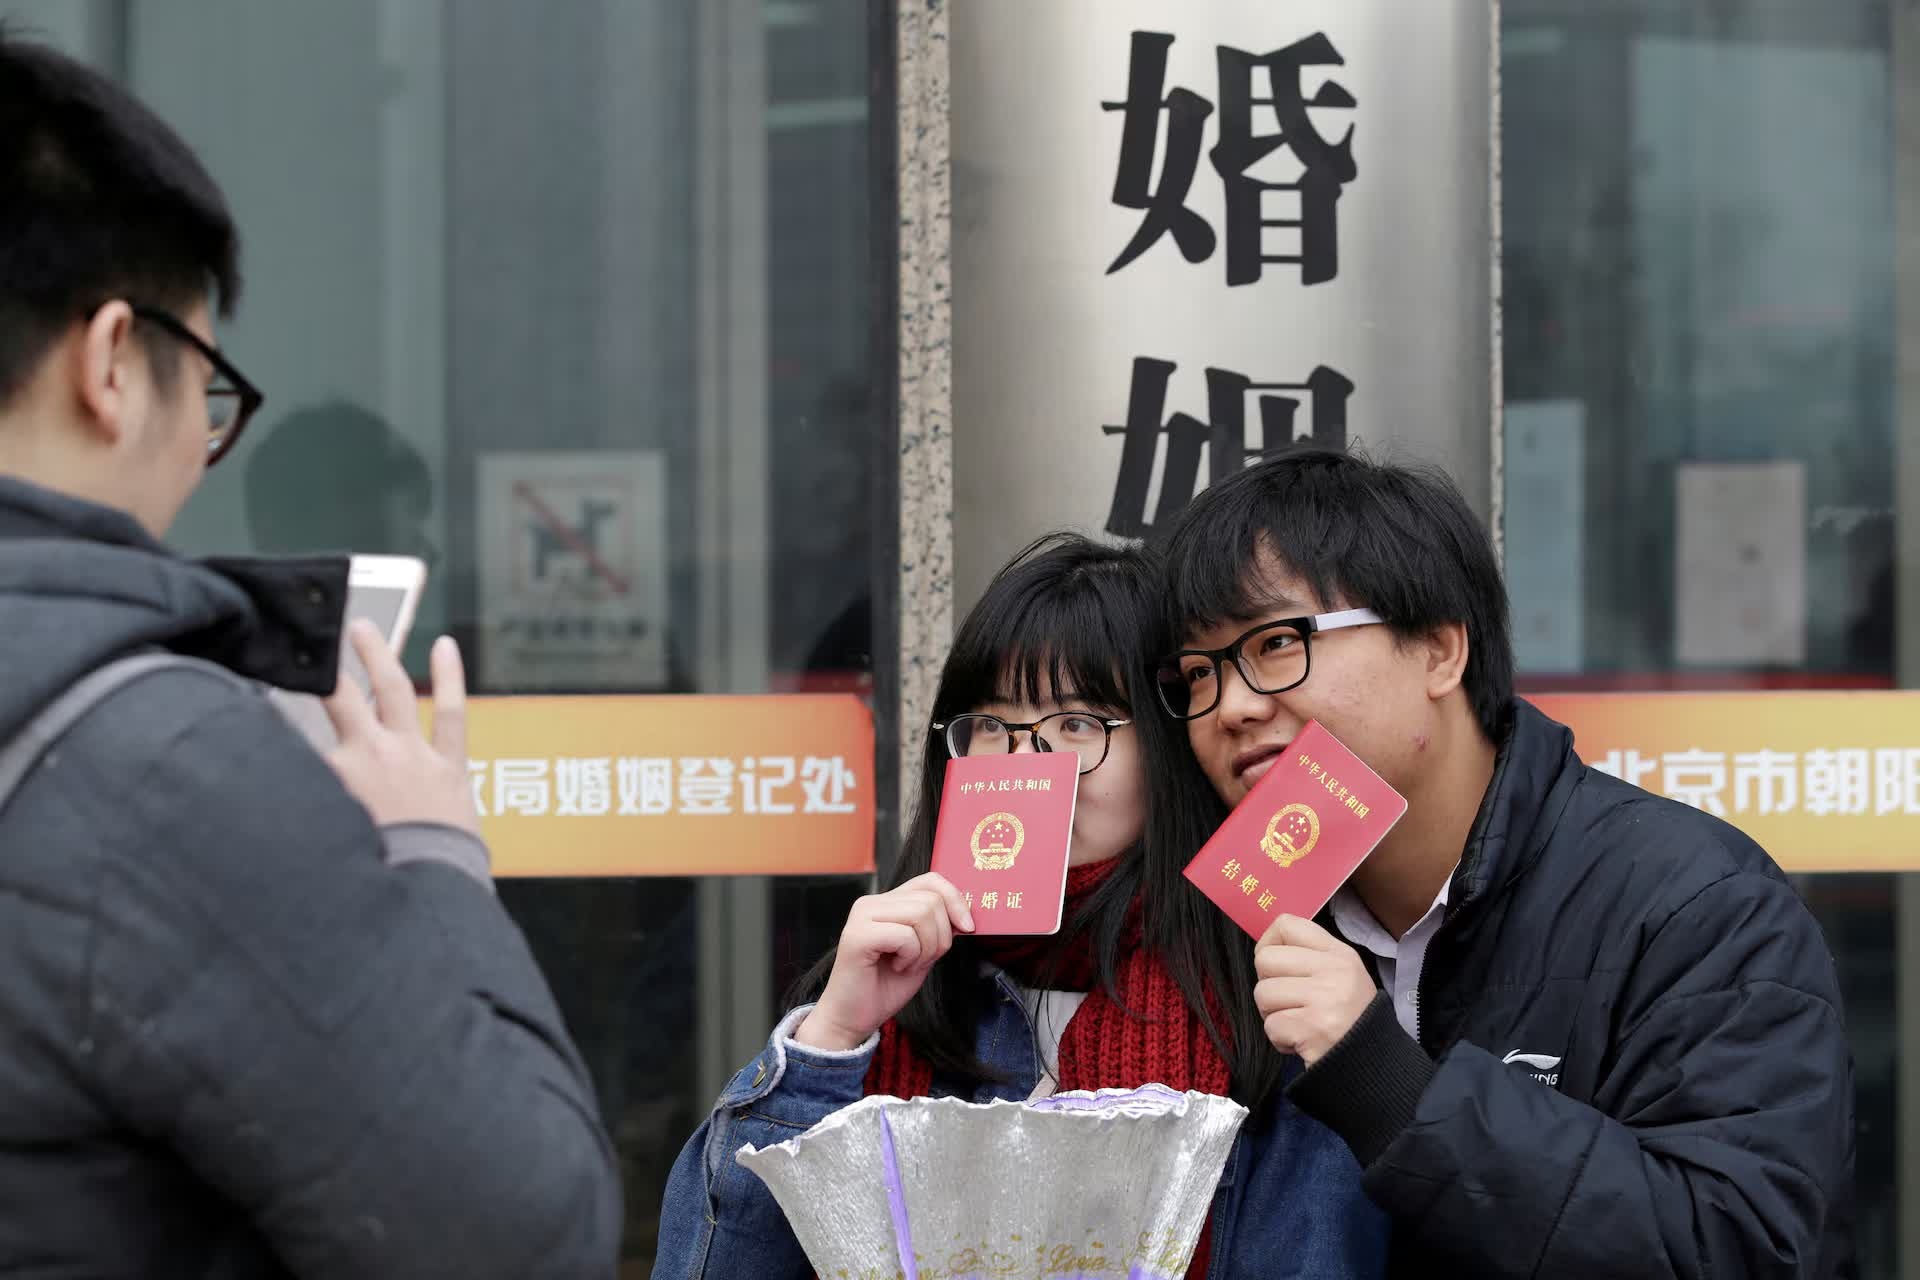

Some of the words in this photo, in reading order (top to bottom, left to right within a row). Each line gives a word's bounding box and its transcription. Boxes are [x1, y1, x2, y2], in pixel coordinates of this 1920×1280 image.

[1100, 30, 1358, 538] 婚姻
[960, 778, 1052, 794] 中华人民共和国
[1298, 754, 1370, 819] 中华人民共和国
[1221, 858, 1277, 912] 结婚证
